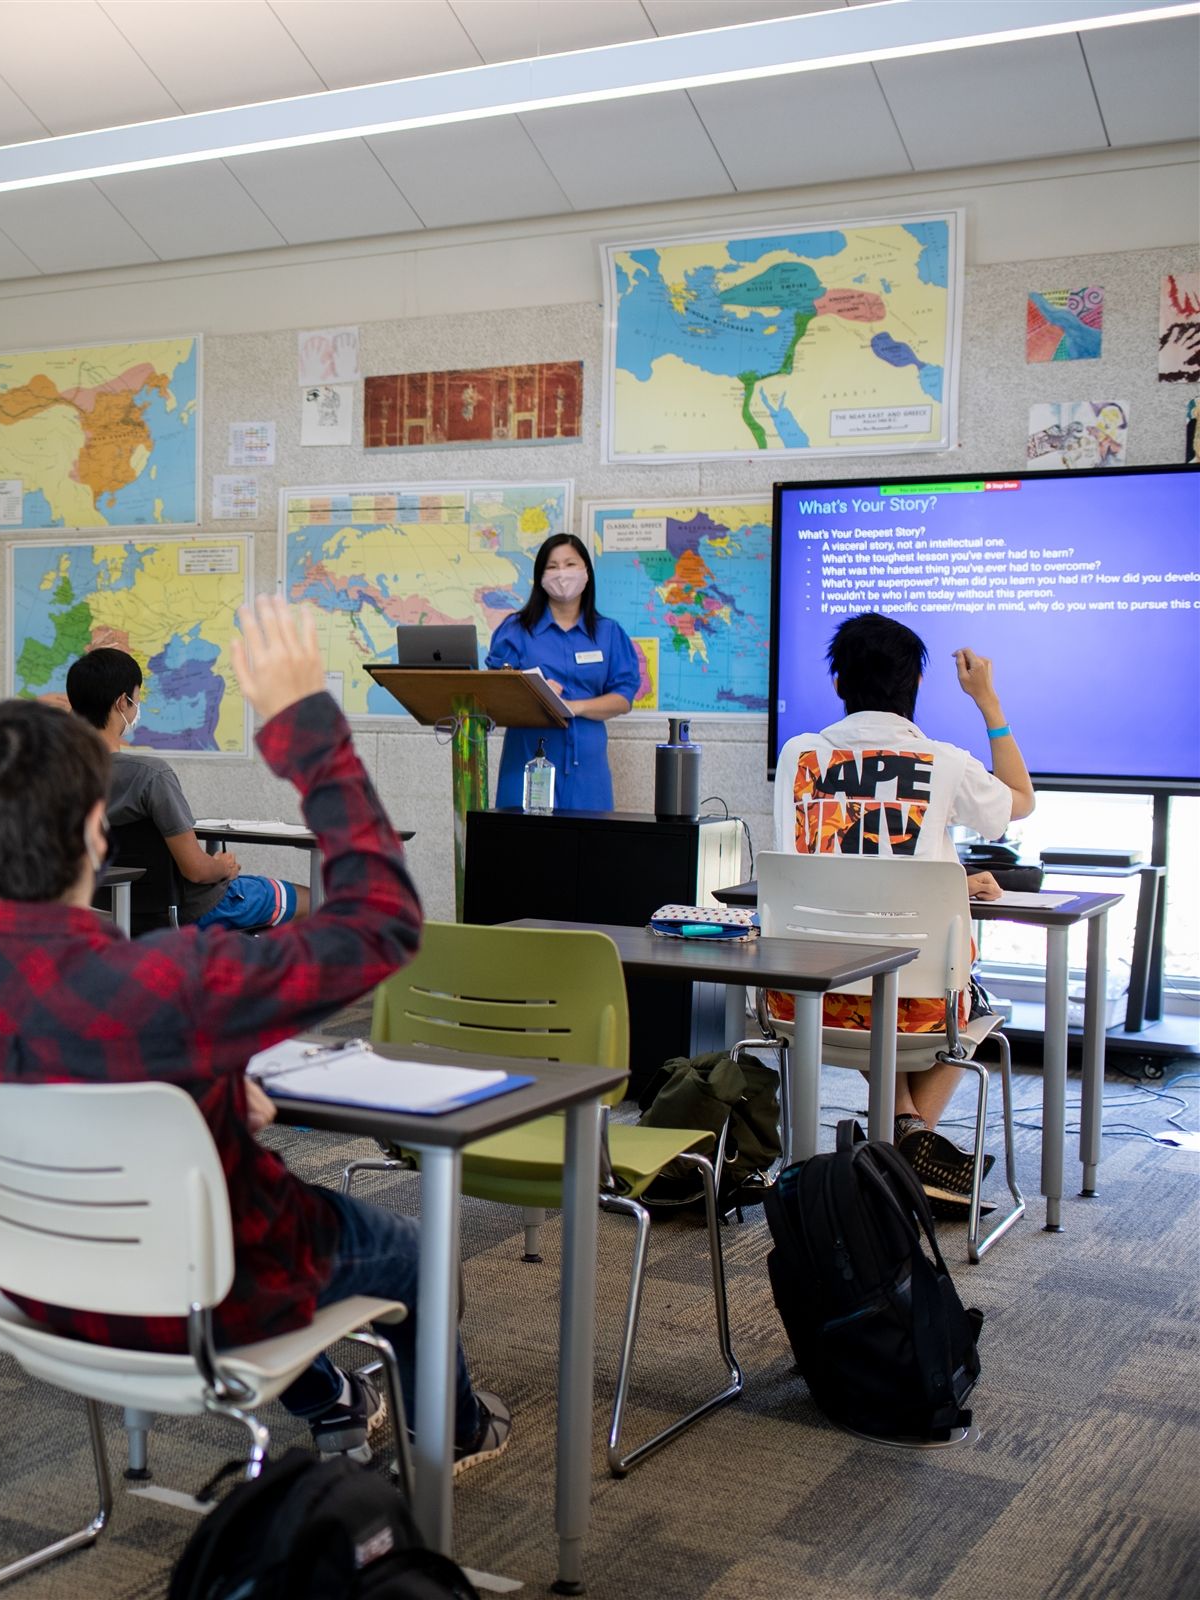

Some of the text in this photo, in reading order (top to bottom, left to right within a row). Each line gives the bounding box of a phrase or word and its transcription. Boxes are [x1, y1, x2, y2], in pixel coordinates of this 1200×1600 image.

[799, 496, 937, 515] What's Your Story?
[798, 527, 926, 540] What's Your Deepest Story?
[822, 542, 830, 551] A
[832, 541, 867, 551] visceral
[870, 541, 895, 551] story,
[897, 540, 912, 549] not
[930, 538, 982, 548] intellectual
[986, 538, 1006, 547] one.
[822, 548, 1074, 564] What's the toughest lesson you've ever had to learn?
[822, 561, 1101, 576] What was the hardest thing you've ever had to overcome?
[822, 579, 852, 588] What's
[855, 579, 875, 590] your
[878, 577, 938, 588] superpower?
[942, 577, 968, 586] When
[971, 576, 986, 585] did
[989, 577, 1007, 587] you
[1010, 575, 1035, 585] learn
[1038, 576, 1056, 587] you
[1059, 574, 1078, 584] had
[1081, 574, 1093, 584] it?
[1096, 574, 1120, 583] How
[1123, 573, 1139, 583] did
[1142, 574, 1162, 585] you
[827, 591, 865, 600] wouldn't
[868, 591, 879, 599] be
[882, 591, 902, 600] who
[928, 591, 954, 601] today
[957, 590, 994, 599] without
[997, 589, 1015, 598] this
[1017, 589, 1055, 599] person.
[822, 604, 828, 613] If
[830, 605, 847, 615] you
[849, 604, 871, 613] have
[882, 603, 918, 614] specific
[921, 603, 984, 613] career/major
[987, 602, 995, 611] in
[998, 601, 1026, 612] mind,
[1029, 601, 1049, 612] why
[1051, 600, 1065, 610] do
[1068, 602, 1086, 612] you
[1089, 600, 1114, 610] want
[1118, 600, 1128, 610] to
[1131, 601, 1168, 611] pursue
[1171, 600, 1191, 609] this
[793, 749, 934, 804] AAPE
[795, 801, 927, 856] UNIV
